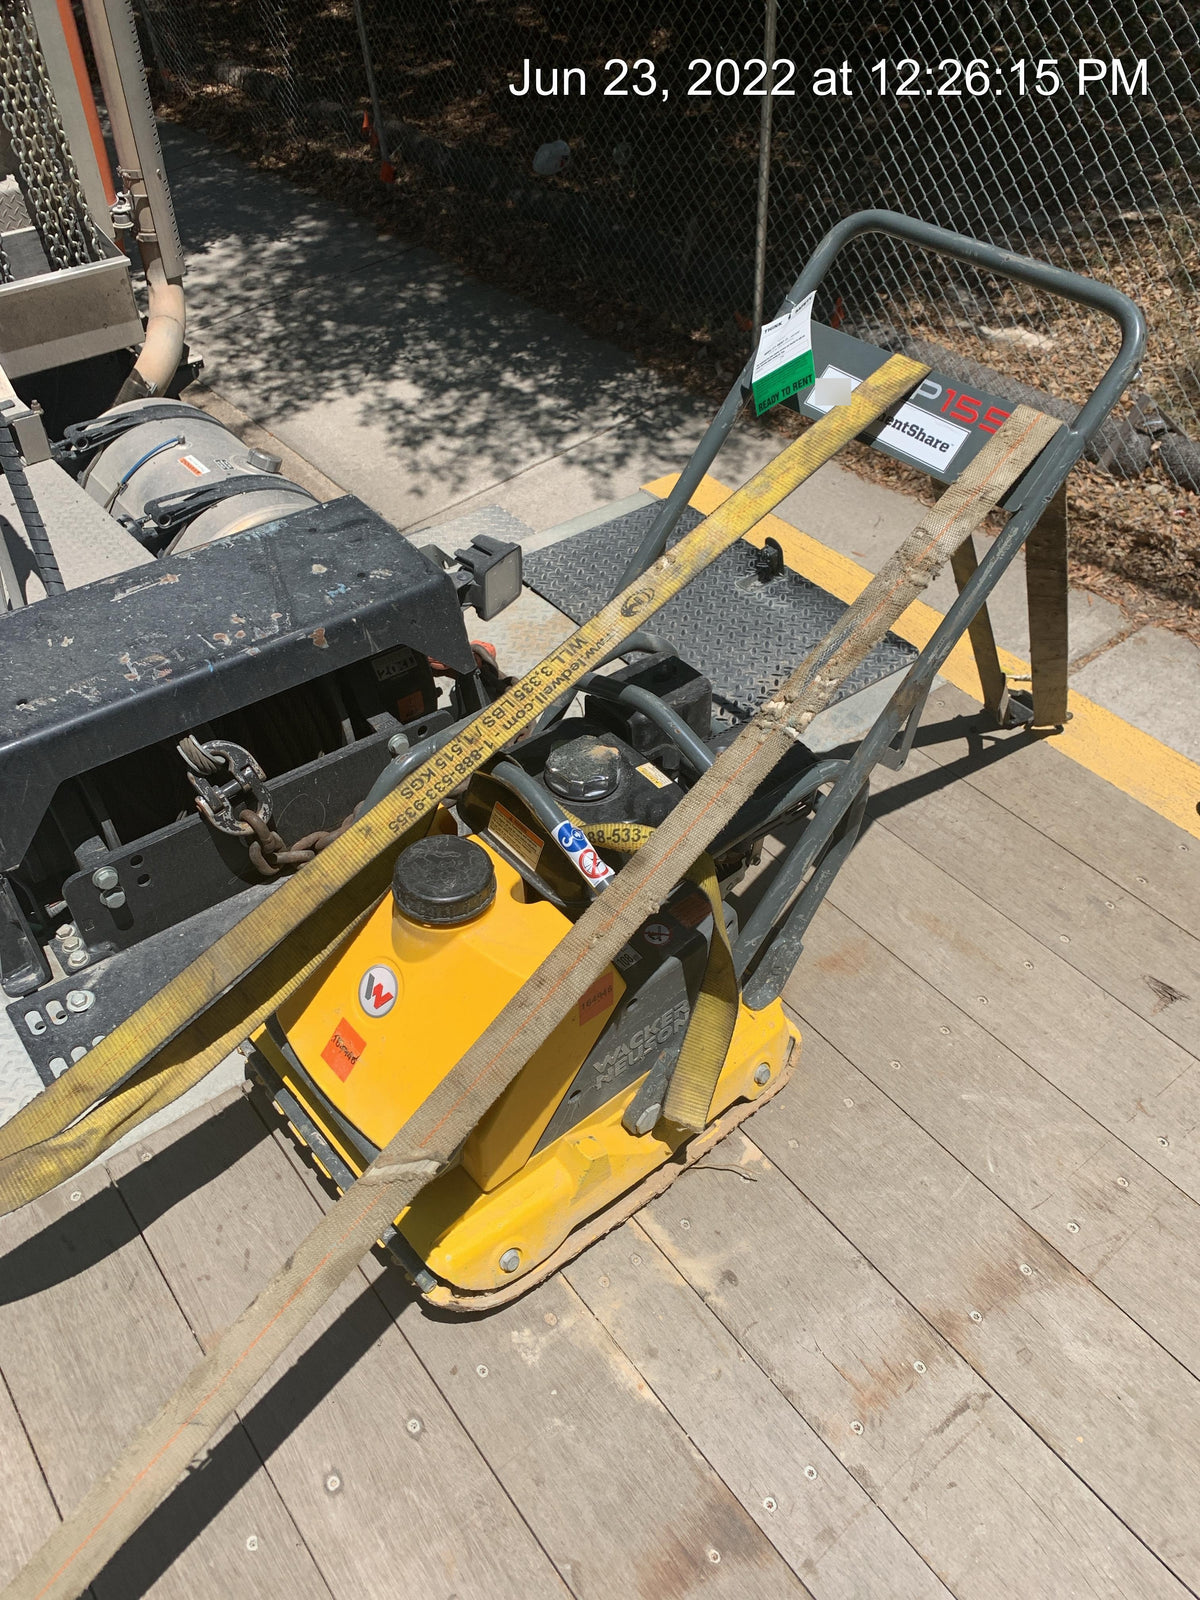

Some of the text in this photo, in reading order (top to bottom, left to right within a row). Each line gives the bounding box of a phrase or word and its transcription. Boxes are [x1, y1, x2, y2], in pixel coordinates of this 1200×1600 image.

[758, 374, 813, 413] READY TO RENT
[550, 634, 587, 668] WLL
[512, 663, 553, 701] 3,335
[481, 698, 514, 729] LBS
[433, 731, 475, 771] 1,515
[386, 735, 494, 834] 1-888-533-9355
[398, 766, 435, 801] KGS
[592, 999, 691, 1073] WACKER
[594, 1013, 690, 1090] NEUSON
